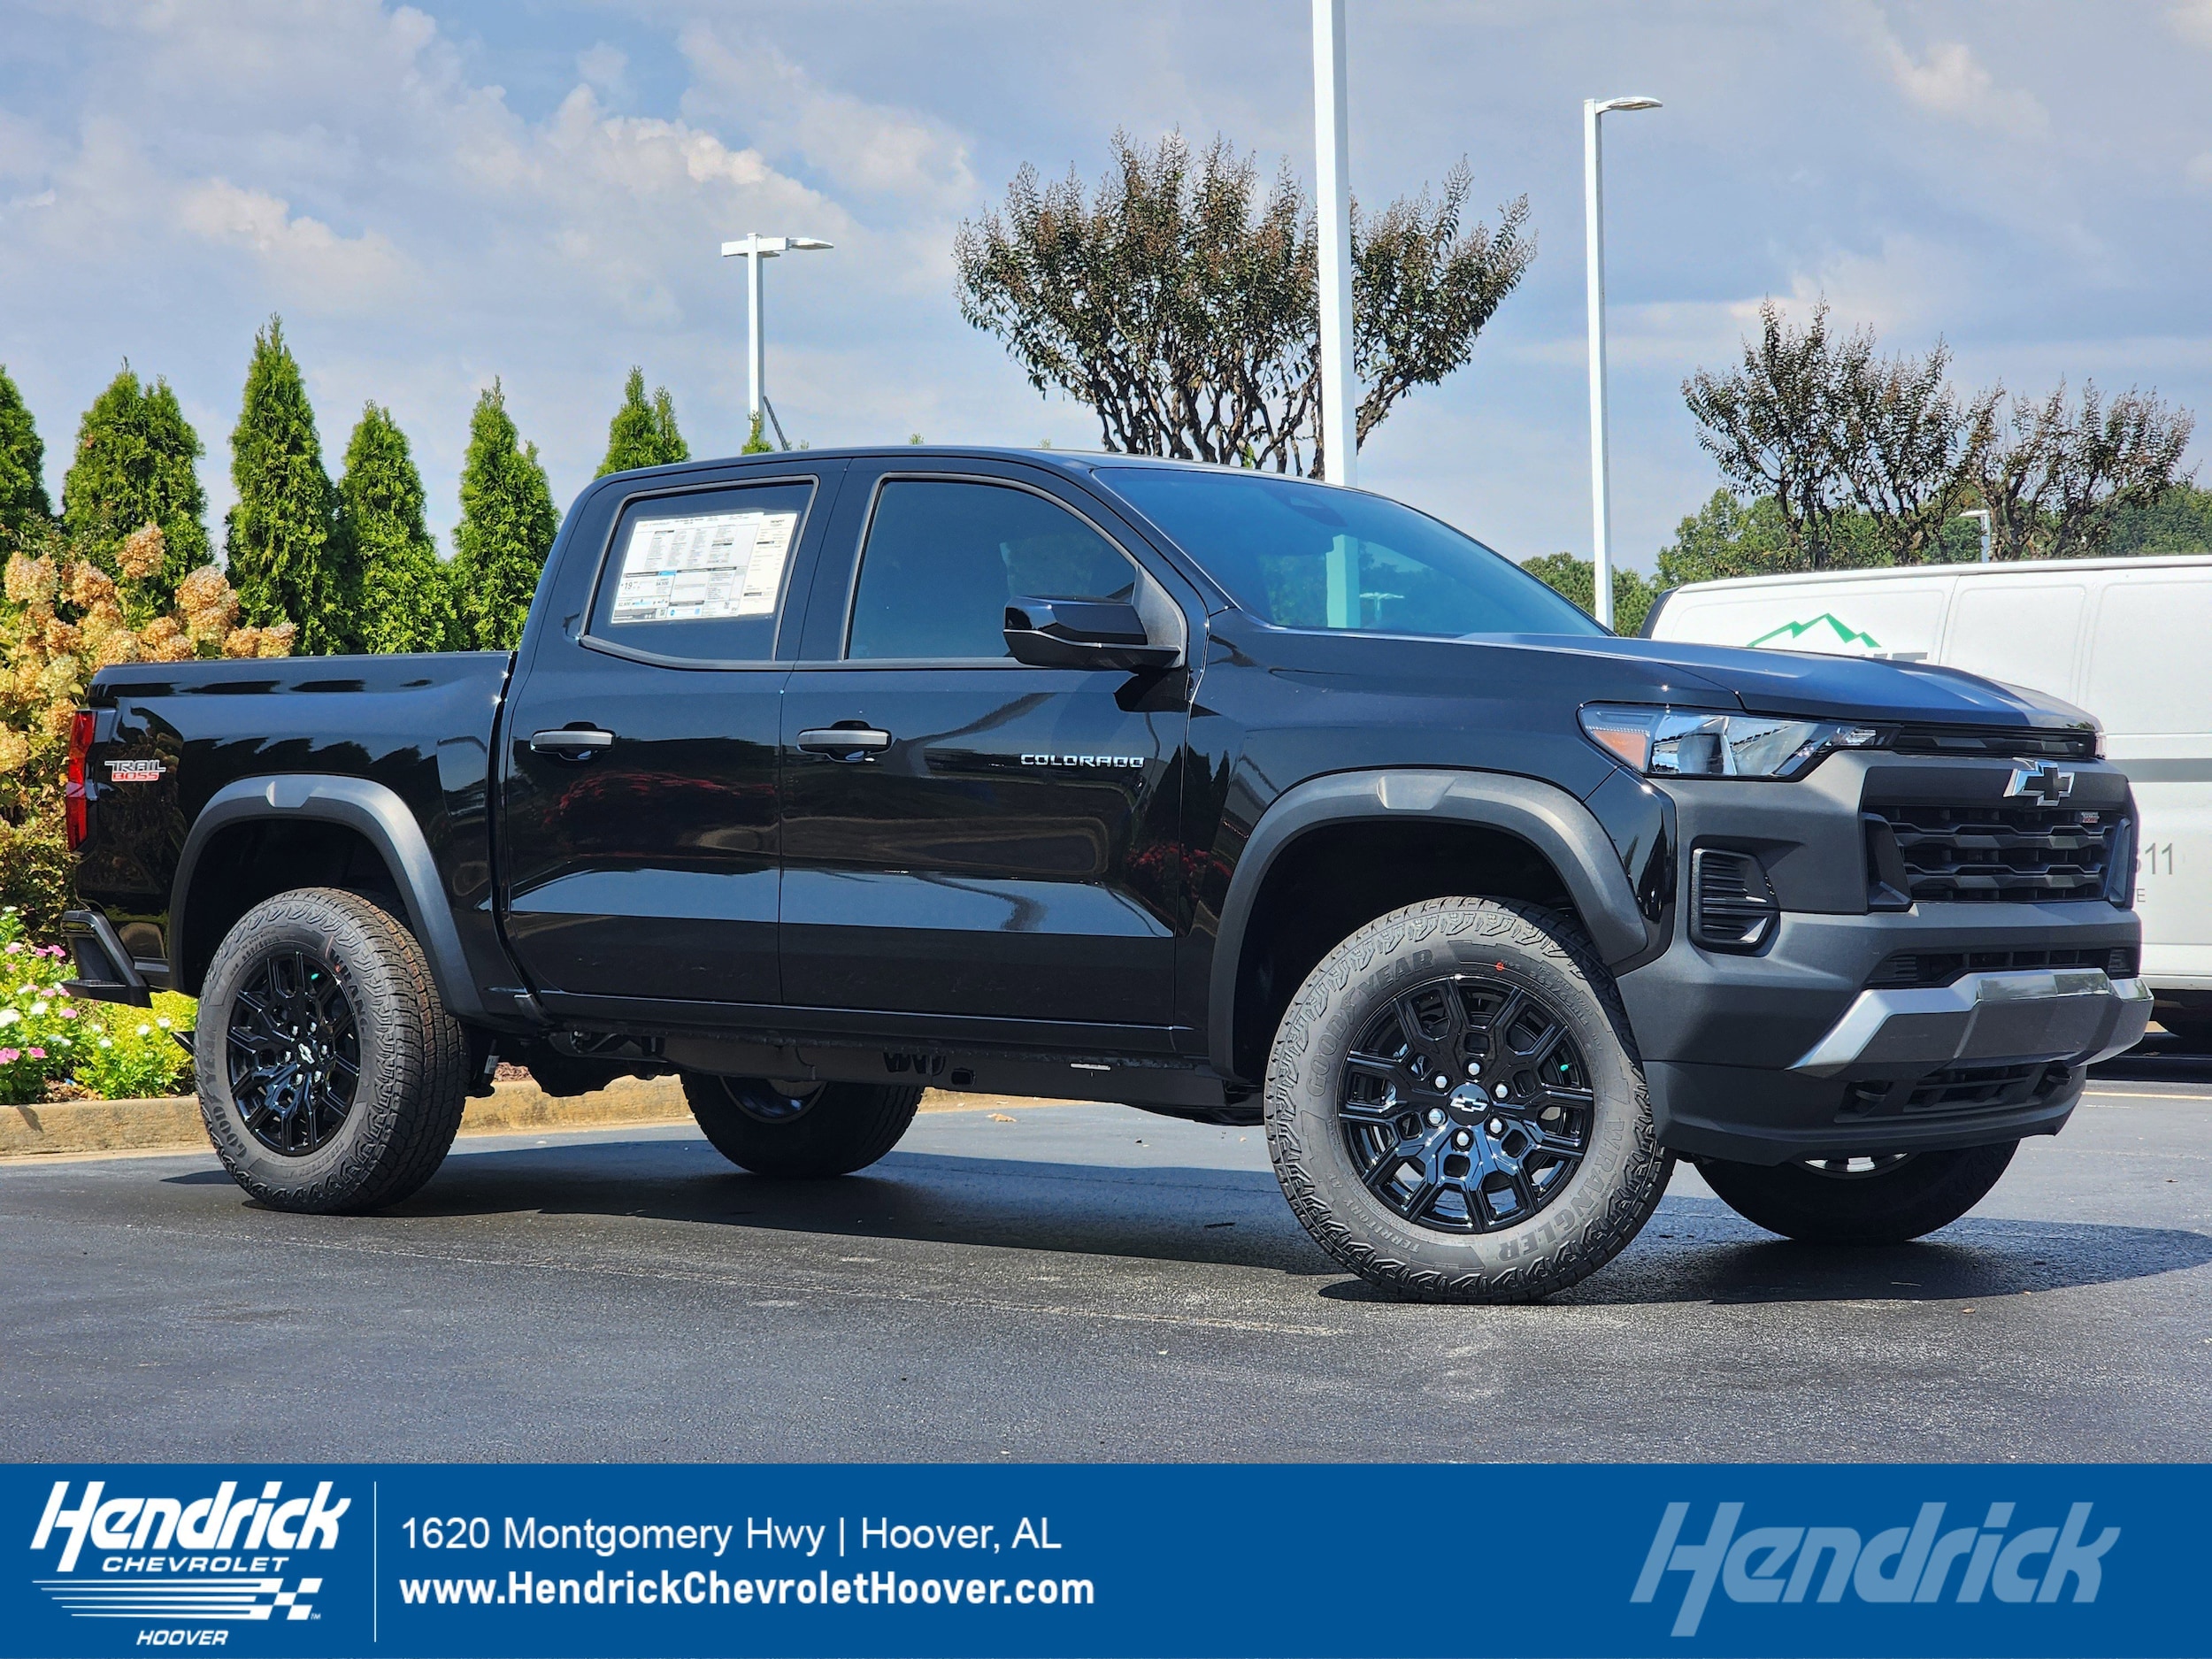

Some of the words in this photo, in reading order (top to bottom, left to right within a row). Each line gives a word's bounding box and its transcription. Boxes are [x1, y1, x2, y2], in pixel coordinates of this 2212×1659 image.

[104, 759, 167, 772] TRAIL
[112, 772, 159, 781] BOSS
[1020, 754, 1145, 768] COLORADO
[1306, 949, 1433, 1097] GOODYEAR
[1498, 1120, 1625, 1262] WRANGLER
[1343, 1198, 1421, 1254] TERRITORY
